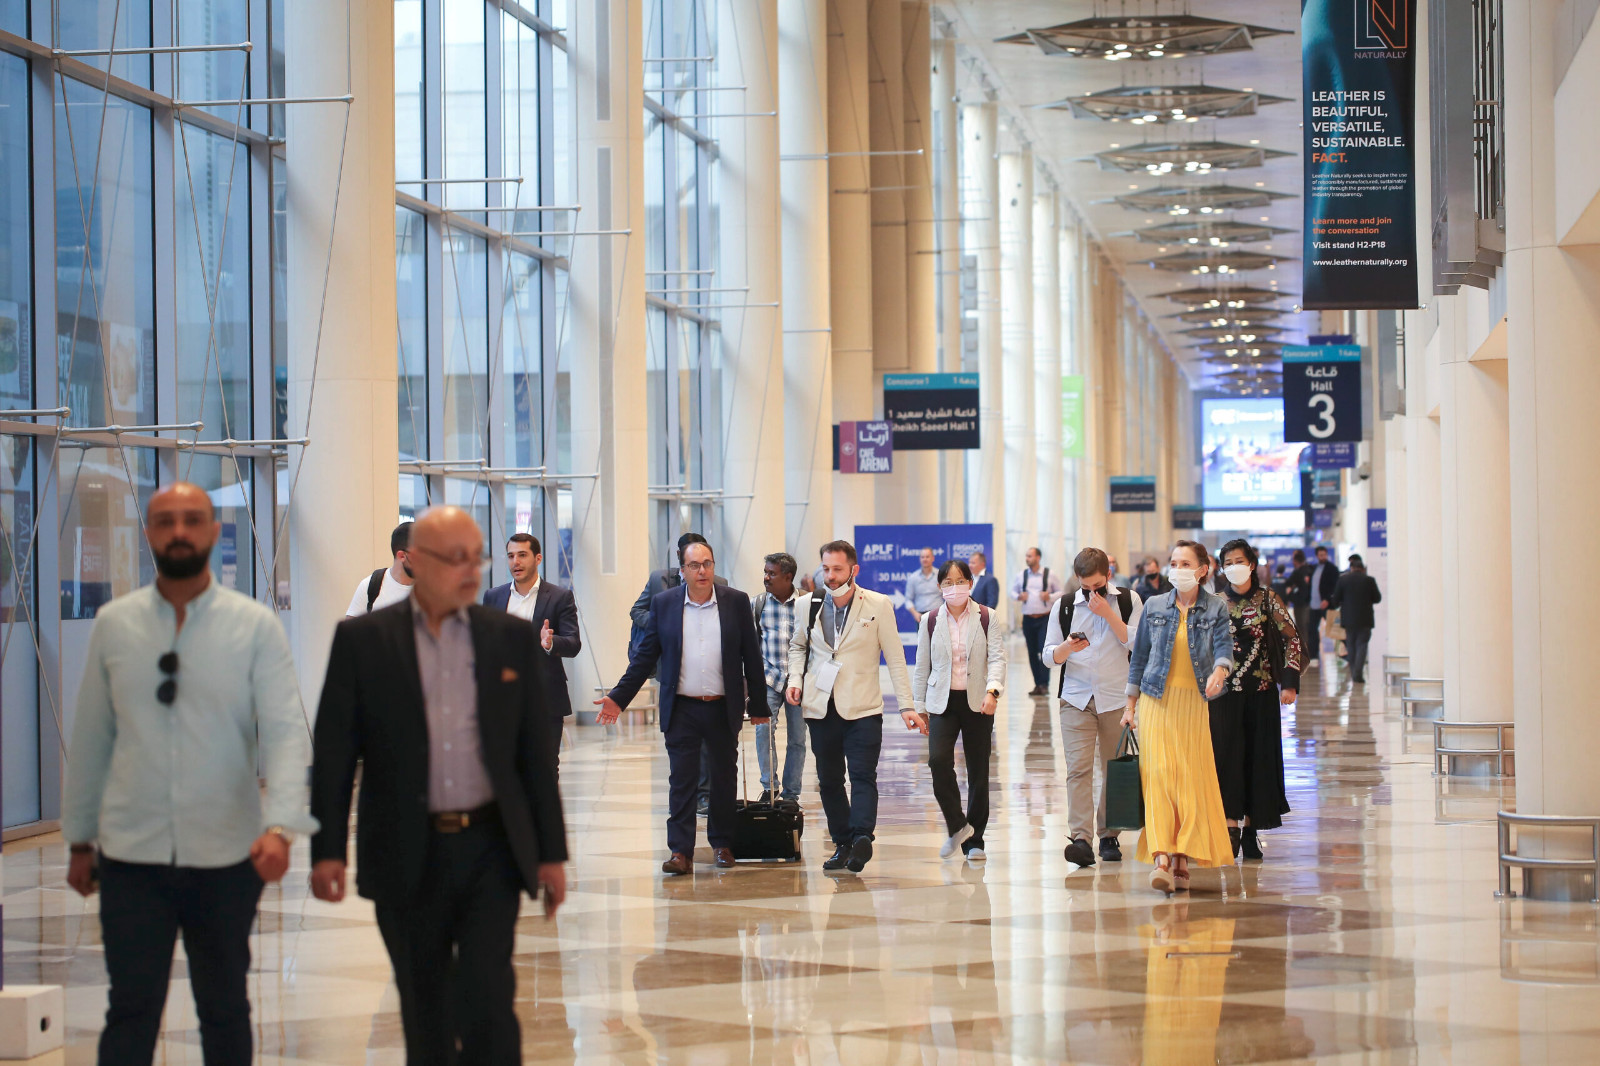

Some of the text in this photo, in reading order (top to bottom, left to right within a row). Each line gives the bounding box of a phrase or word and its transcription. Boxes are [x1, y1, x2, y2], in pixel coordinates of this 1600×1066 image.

[1354, 51, 1407, 59] NATURALLY
[1312, 90, 1386, 101] LEATHER IS
[1312, 106, 1388, 118] BEAUTIFUL,
[1312, 121, 1385, 133] VERSATILE,
[1312, 136, 1405, 148] SUSTAINABLE.
[1312, 152, 1348, 163] FACT.
[1313, 217, 1335, 225] Learn
[1376, 217, 1392, 226] join
[1313, 241, 1331, 249] Visit
[1332, 241, 1355, 249] stand
[1313, 258, 1408, 267] www.leathernaturally.org
[1305, 365, 1338, 378] قاعة
[886, 376, 930, 386] Concourse 1
[1310, 381, 1333, 392] Hall
[953, 407, 978, 418] قاعة
[1307, 393, 1336, 439] 3
[920, 421, 948, 431] Saeed
[950, 421, 969, 431] Hall
[970, 421, 976, 430] 1
[860, 457, 890, 471] ARENA
[863, 544, 894, 555] APLF
[878, 572, 890, 582] 30
